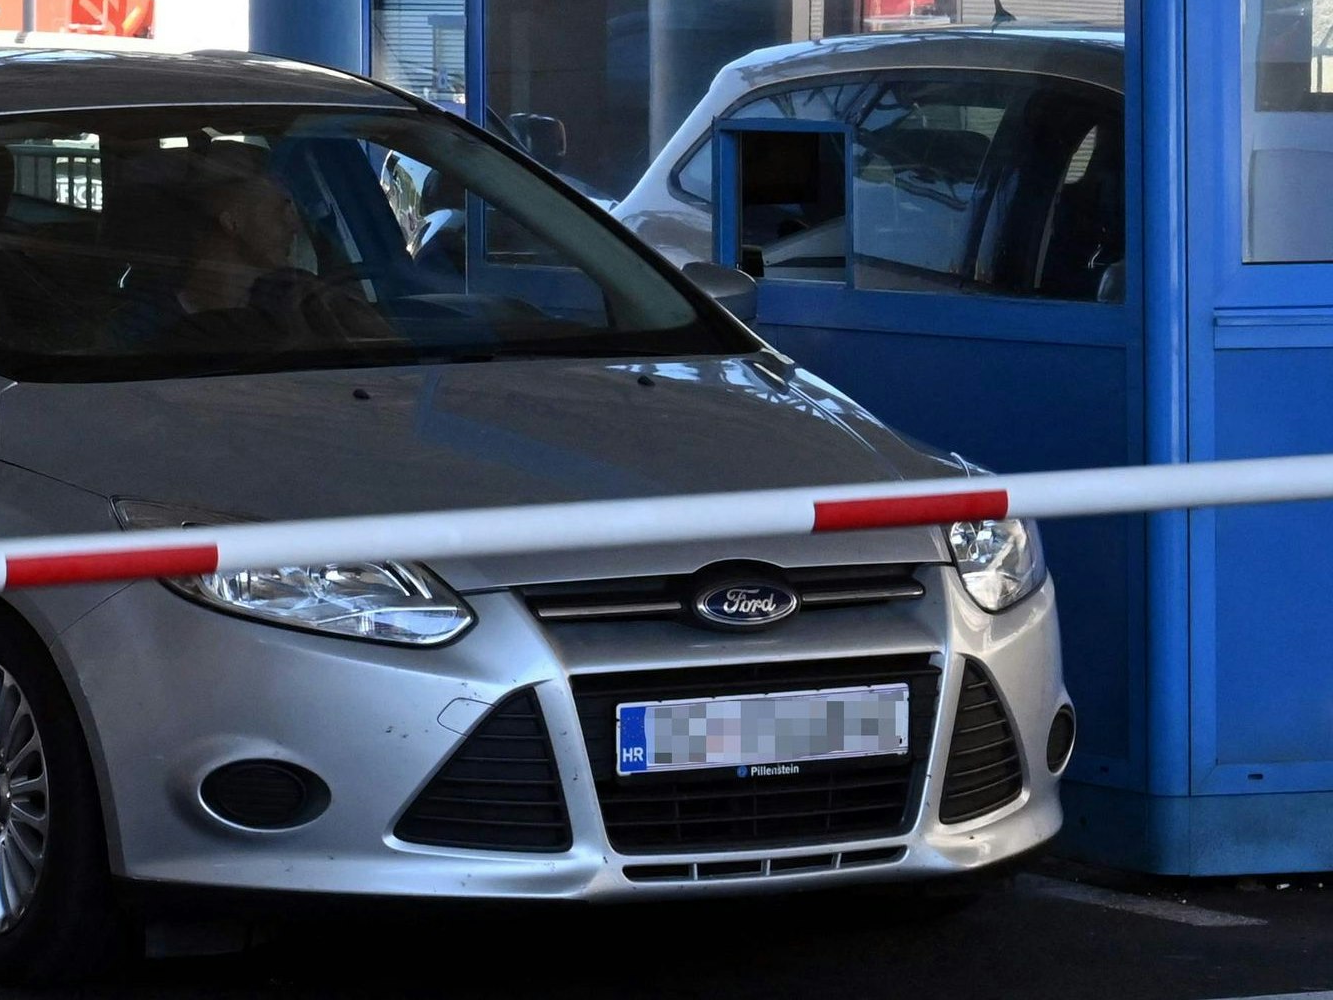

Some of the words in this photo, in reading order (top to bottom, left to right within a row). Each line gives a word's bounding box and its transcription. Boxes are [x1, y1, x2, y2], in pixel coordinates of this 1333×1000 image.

[723, 588, 776, 614] Ford
[622, 747, 644, 763] HR
[750, 763, 800, 777] Pillenstein
